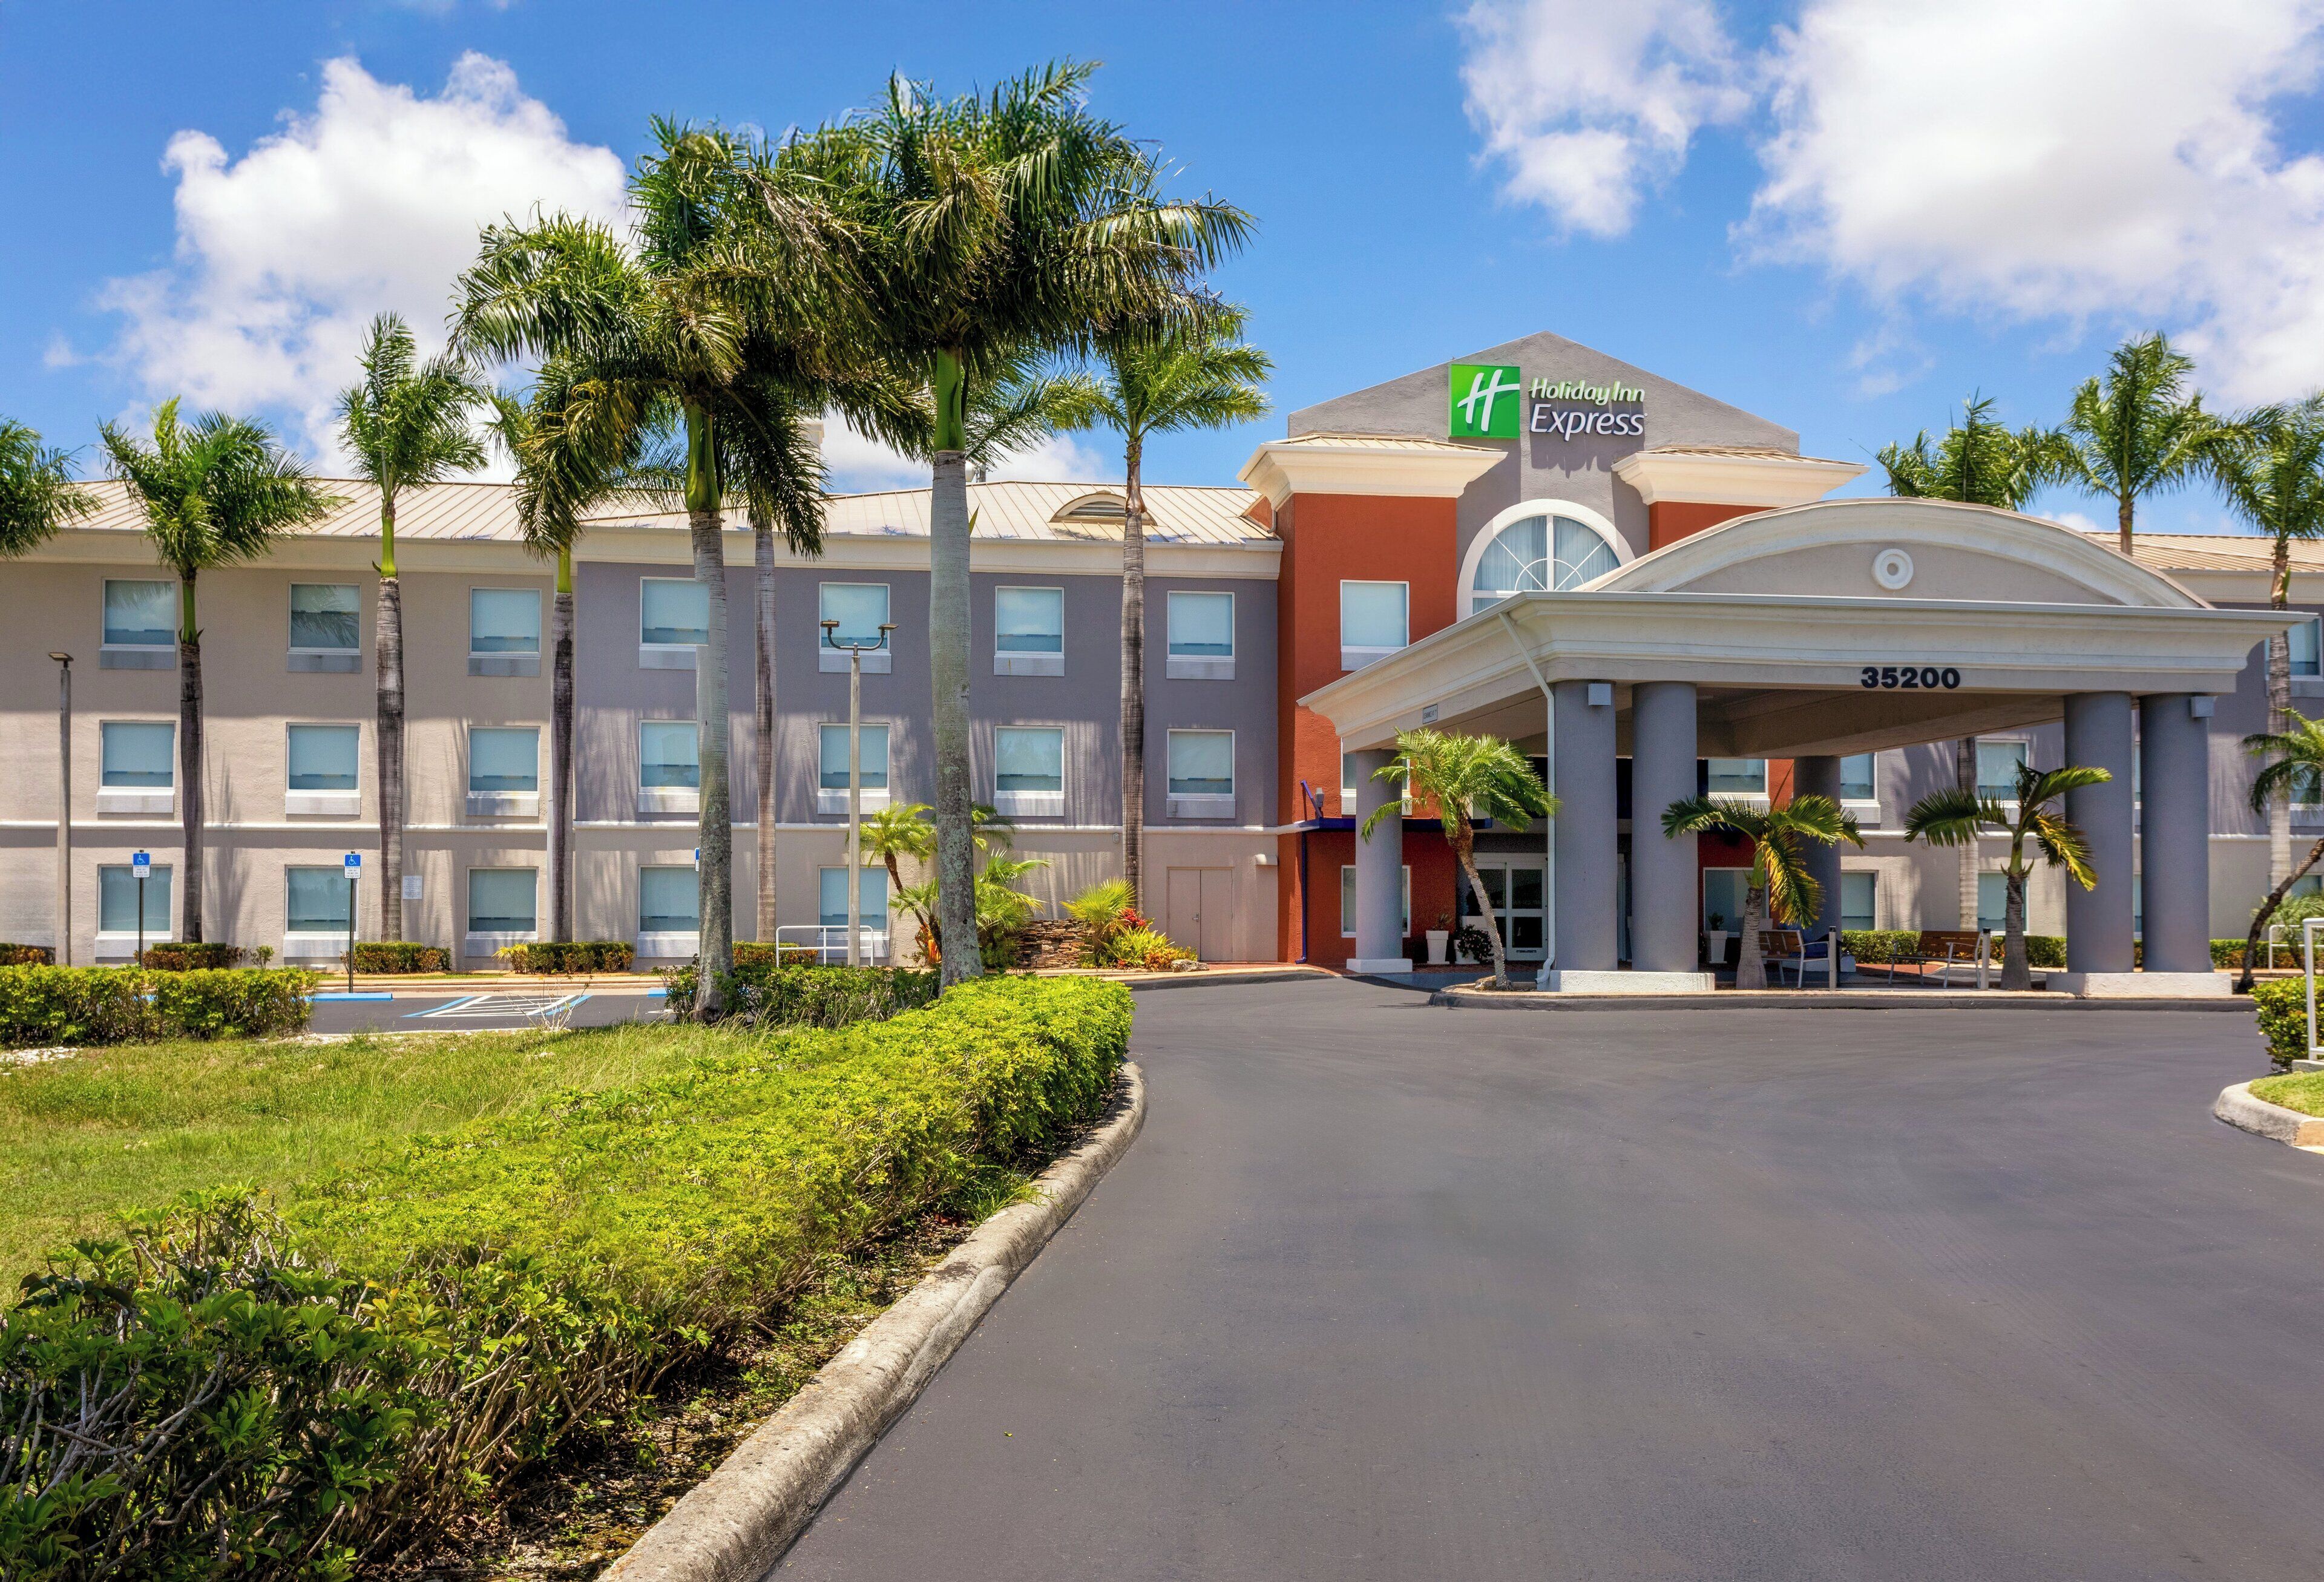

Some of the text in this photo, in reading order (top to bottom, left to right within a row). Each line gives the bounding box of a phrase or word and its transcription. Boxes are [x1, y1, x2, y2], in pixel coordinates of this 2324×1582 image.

[1528, 377, 1645, 406] Holiday Inn
[1530, 403, 1645, 442] Express
[1861, 667, 1960, 689] 35200
